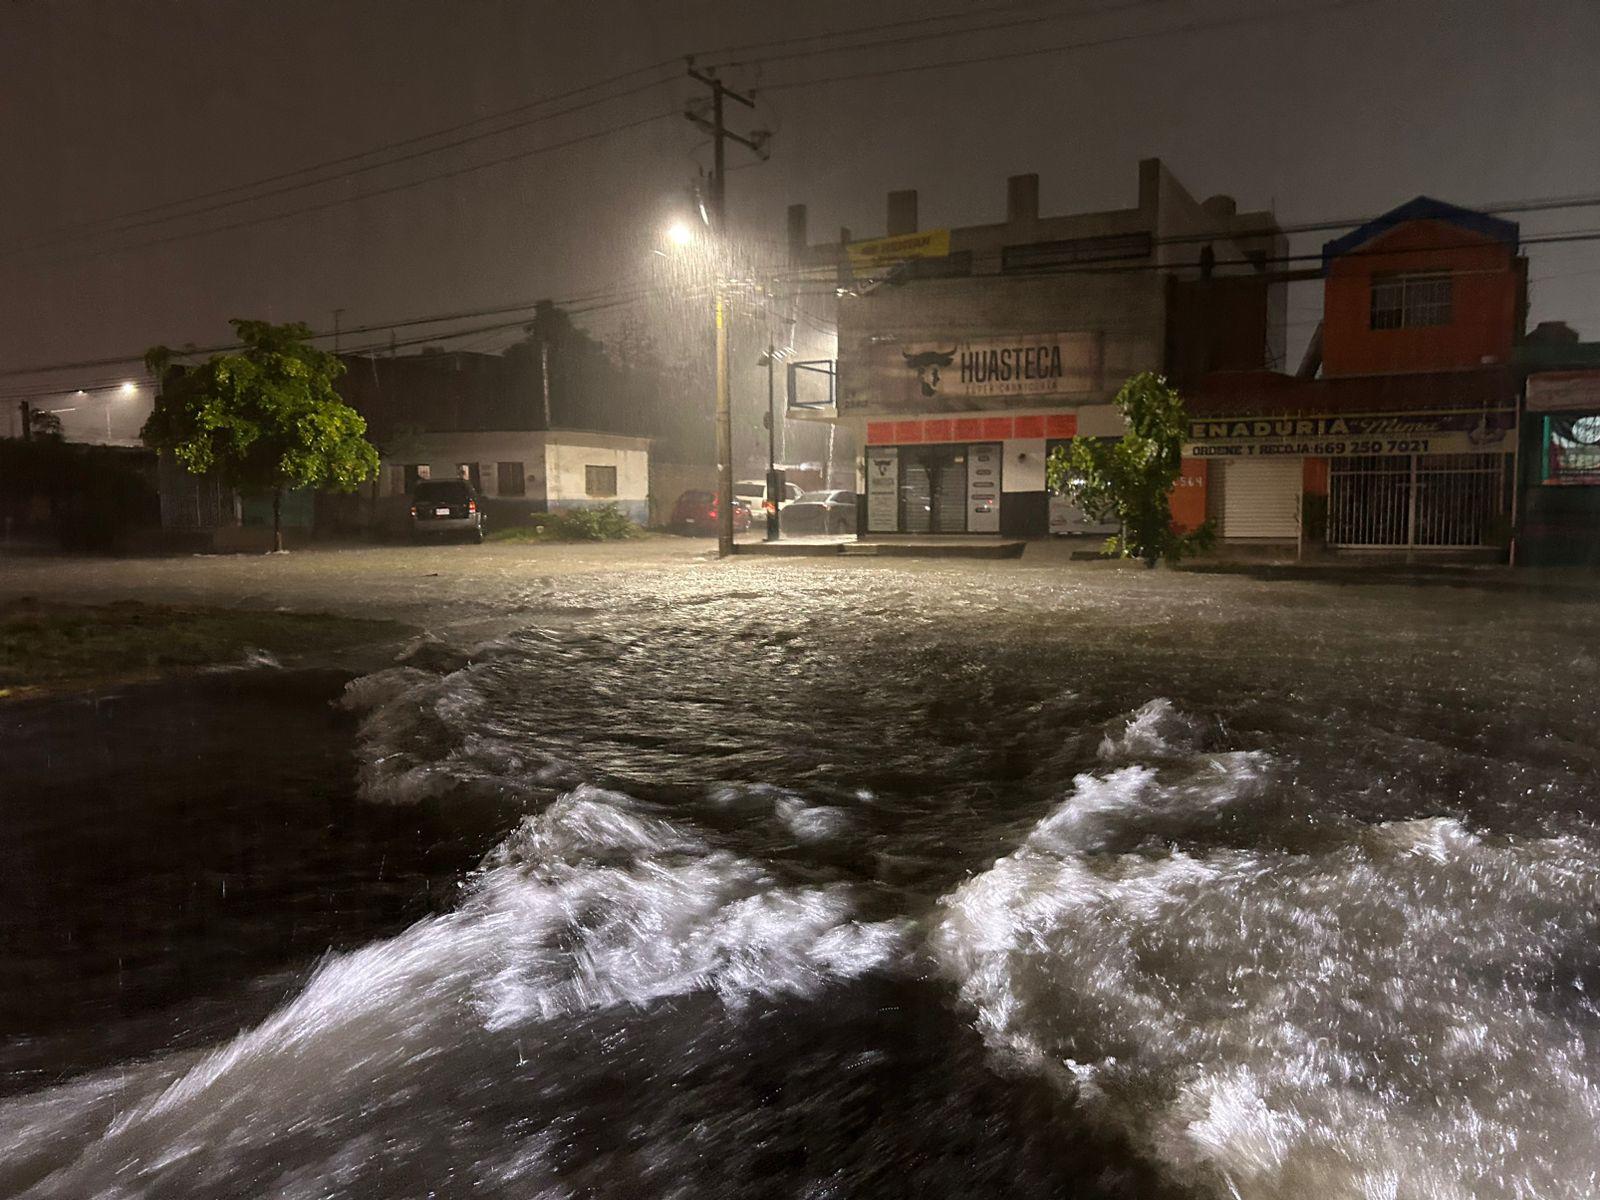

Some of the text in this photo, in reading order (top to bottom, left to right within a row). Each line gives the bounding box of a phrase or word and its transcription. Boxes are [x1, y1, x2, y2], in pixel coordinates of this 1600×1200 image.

[961, 345, 1062, 384] HUASTECA
[1192, 416, 1350, 439] ENADURIA
[1193, 446, 1242, 456] ORDENE
[1351, 441, 1383, 453] 250
[1387, 440, 1430, 452] 7021
